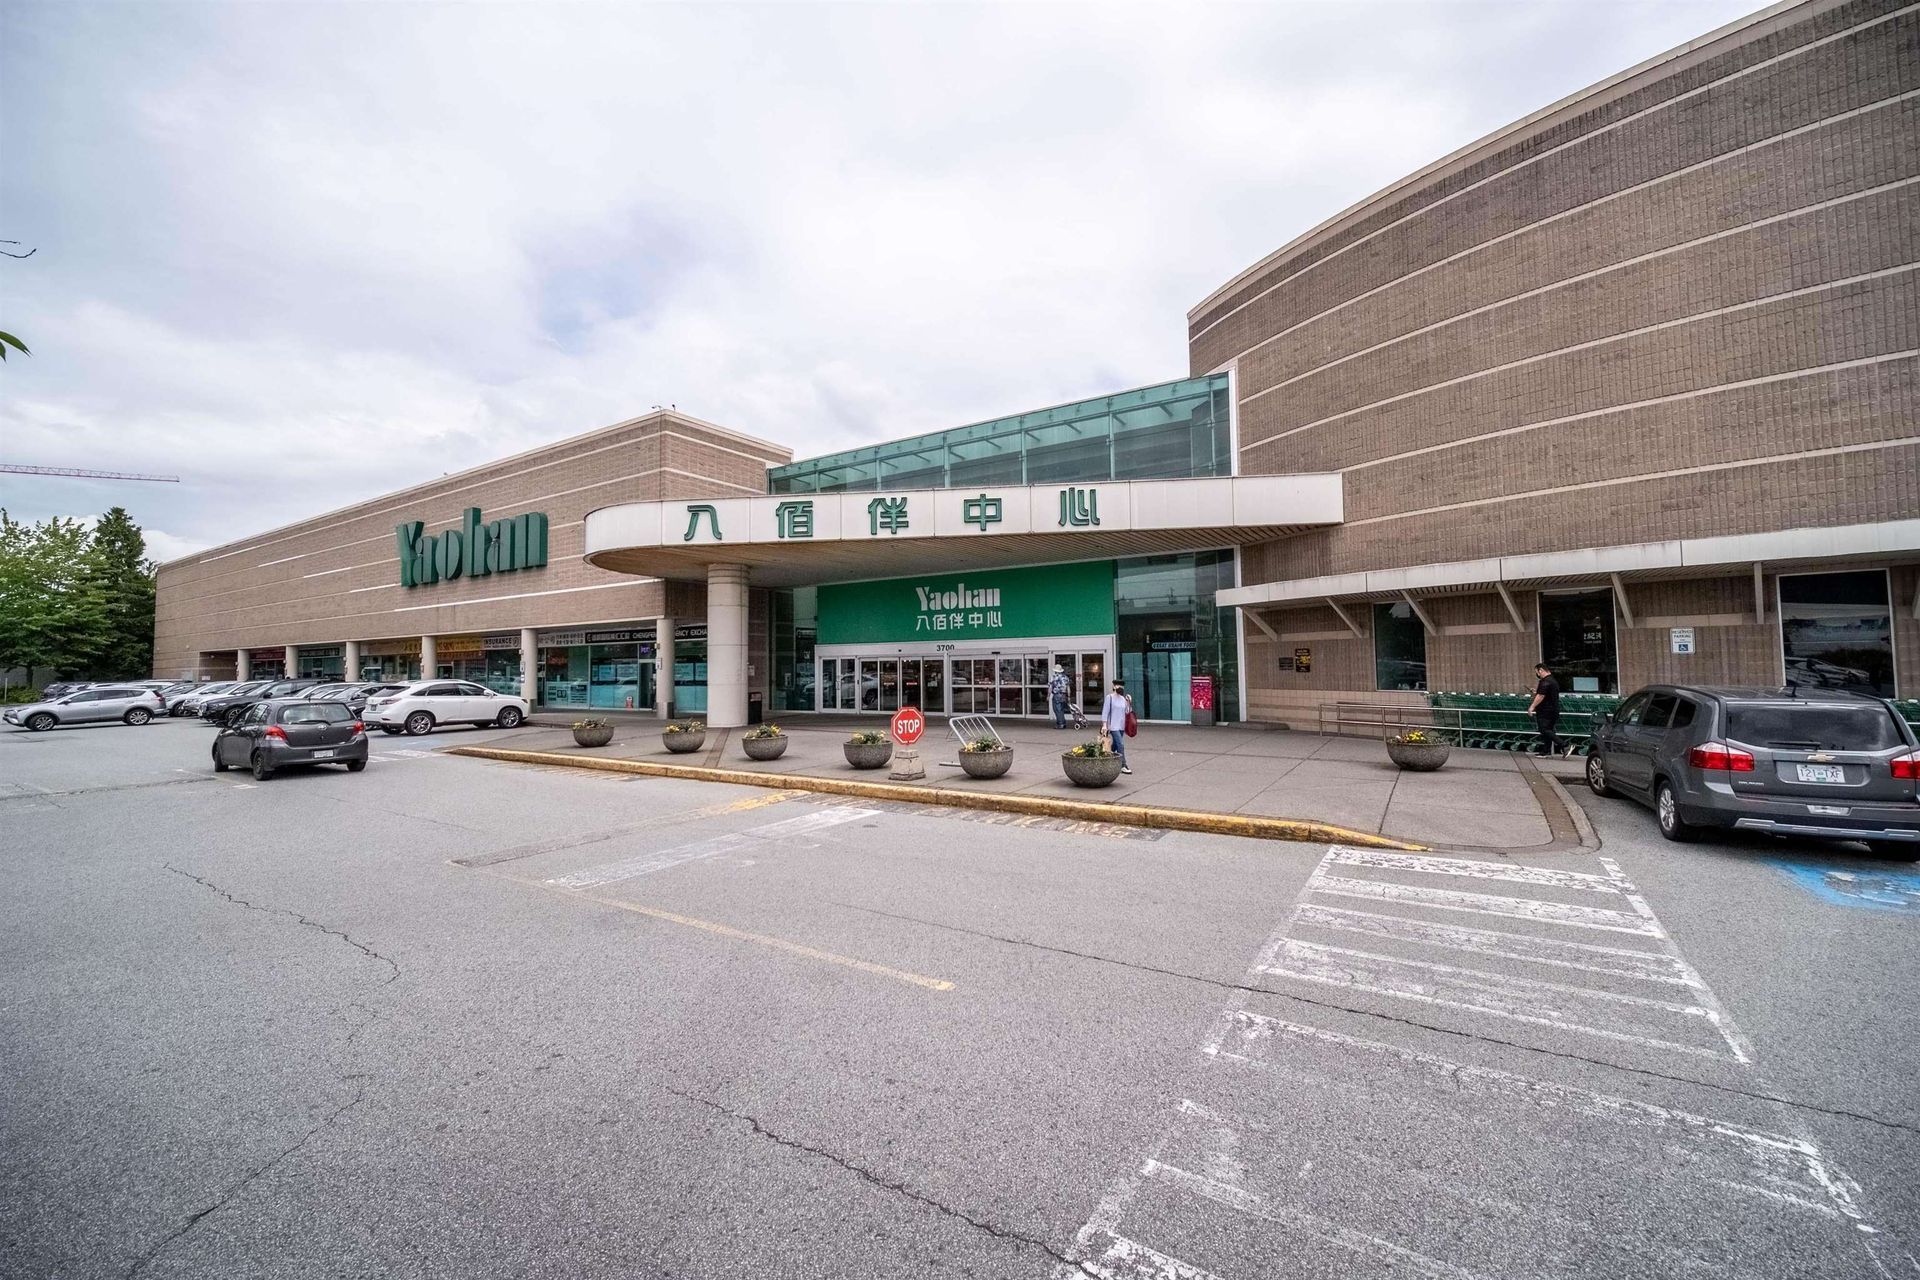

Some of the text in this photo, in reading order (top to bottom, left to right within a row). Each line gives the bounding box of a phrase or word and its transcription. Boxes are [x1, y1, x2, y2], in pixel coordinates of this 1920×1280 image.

[684, 487, 1101, 542] 八佰伴中心
[397, 507, 549, 587] Yaohan
[915, 583, 1000, 611] Yaohan
[916, 611, 1003, 631] 八佰伴中心
[484, 637, 512, 646] INSURANCE
[936, 644, 955, 652] 3700
[897, 719, 920, 734] STOP
